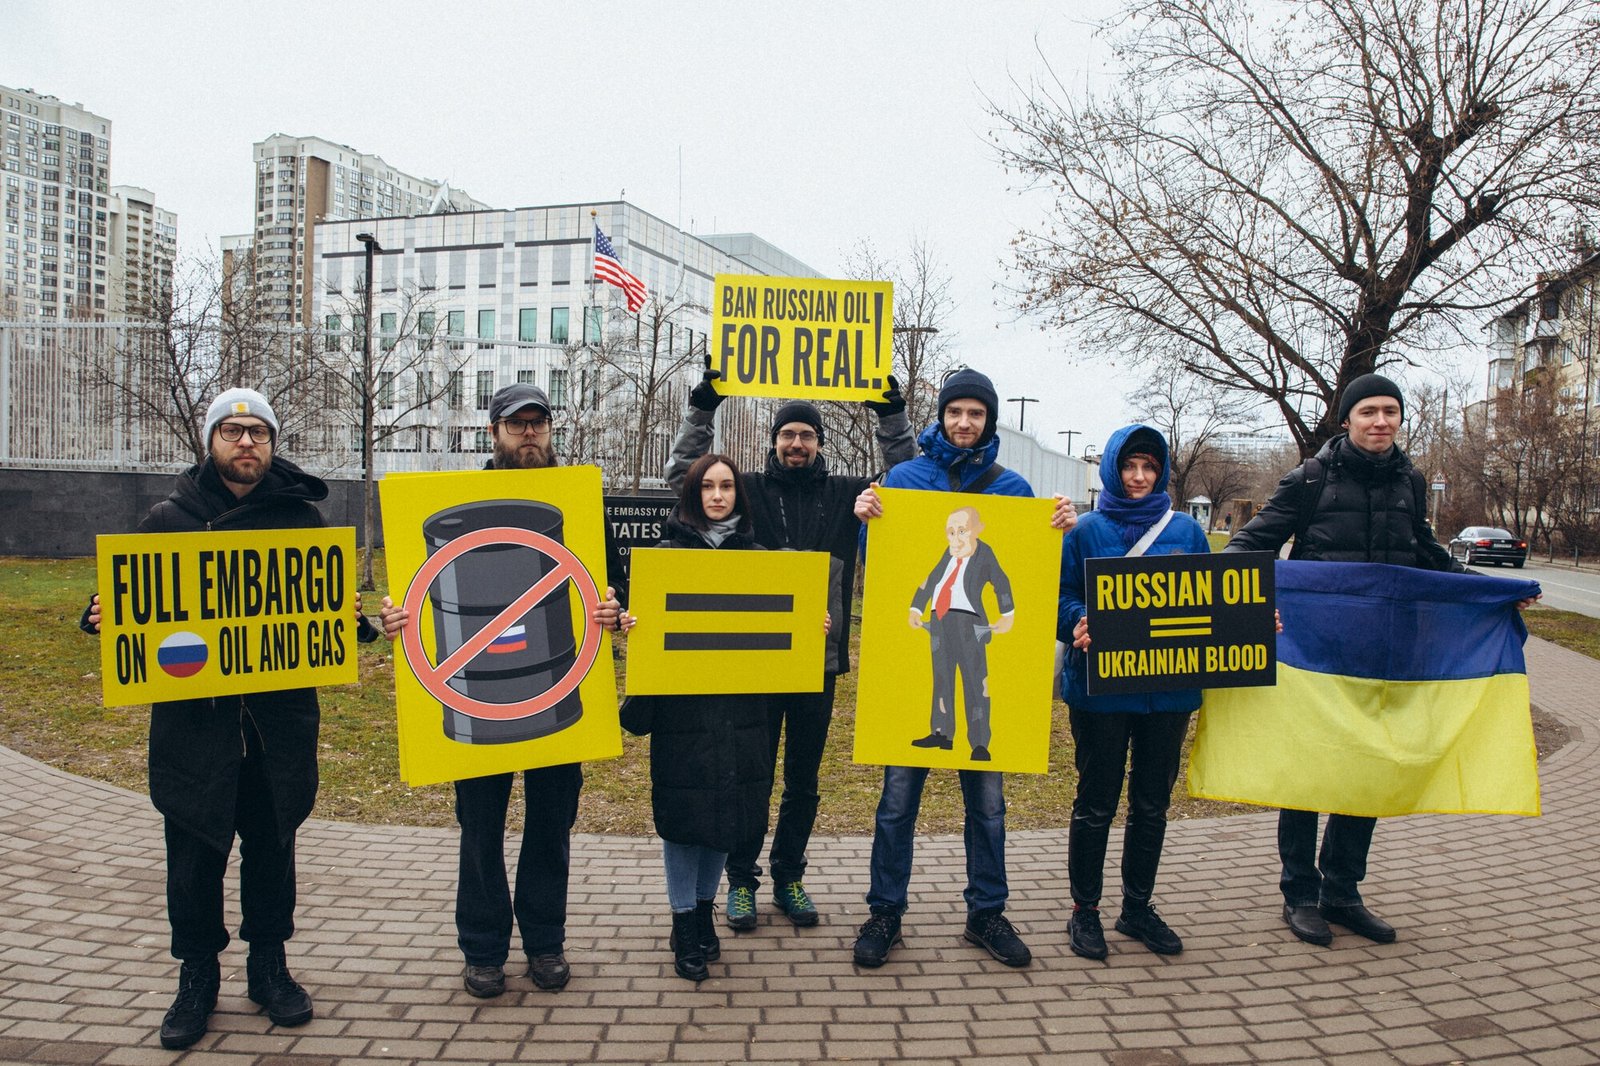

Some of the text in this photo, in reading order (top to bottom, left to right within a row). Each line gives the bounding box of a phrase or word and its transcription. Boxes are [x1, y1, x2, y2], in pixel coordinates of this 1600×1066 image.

[722, 285, 870, 324] BAN RUSSIAN OIL
[720, 323, 781, 385] FOR
[611, 522, 662, 539] TATES
[614, 507, 657, 517] EMBASSY
[659, 507, 672, 517] OF
[112, 544, 344, 626] FULL EMBARGO
[1096, 568, 1267, 611] RUSSIAN OIL
[116, 618, 346, 686] ON OIL AND GAS
[1098, 644, 1268, 679] UKRAINIAN BLOOD
